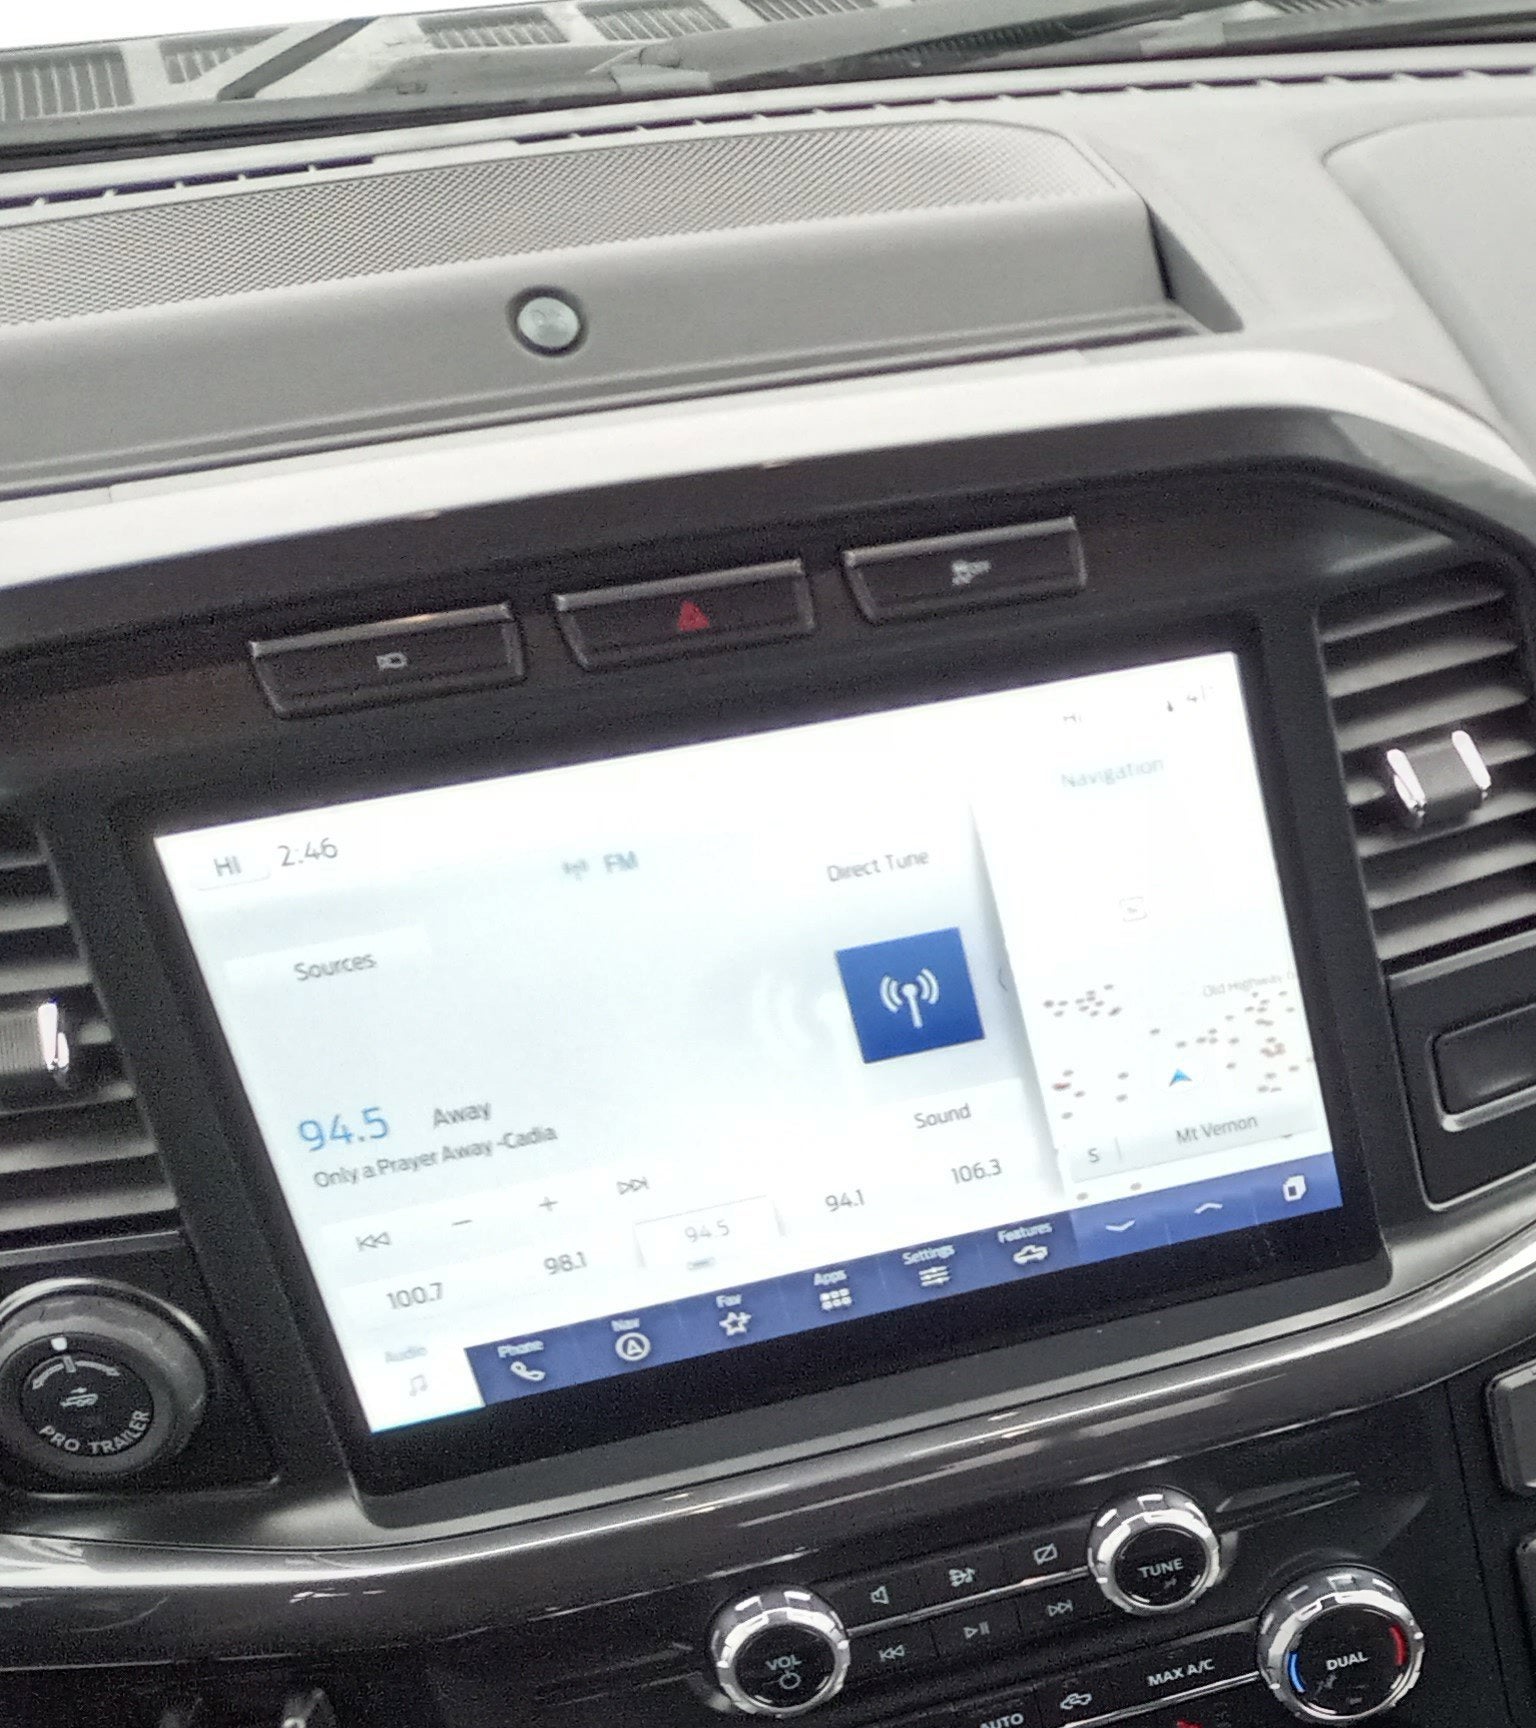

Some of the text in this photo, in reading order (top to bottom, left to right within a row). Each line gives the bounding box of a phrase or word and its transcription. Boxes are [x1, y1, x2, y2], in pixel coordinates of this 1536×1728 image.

[1060, 758, 1165, 789] Navigation
[212, 837, 339, 877] HI 2:46
[602, 849, 640, 873] FM
[827, 846, 930, 884] Direct Tune
[292, 952, 378, 982] Sources
[298, 1100, 493, 1152] 94.5 Away
[913, 1102, 972, 1130] Sound
[1088, 1115, 1260, 1164] S Mt Vernon
[313, 1165, 359, 1188] Only
[362, 1164, 377, 1179] a
[377, 1150, 438, 1176] Prayer
[442, 1138, 494, 1163] Away
[386, 1281, 444, 1310] 100.7
[543, 1250, 588, 1276] 98.1
[824, 1188, 865, 1213] 94.1
[950, 1157, 1003, 1184] 106.3
[813, 1269, 848, 1287] Apps
[902, 1244, 956, 1266] Settings
[997, 1222, 1053, 1244] Features
[38, 1409, 151, 1455] PRO TRAILER
[1138, 1557, 1186, 1580] TUNE
[765, 1654, 803, 1673] VOL
[1147, 1658, 1216, 1687] MAX A/C
[1325, 1651, 1369, 1673] DUAL
